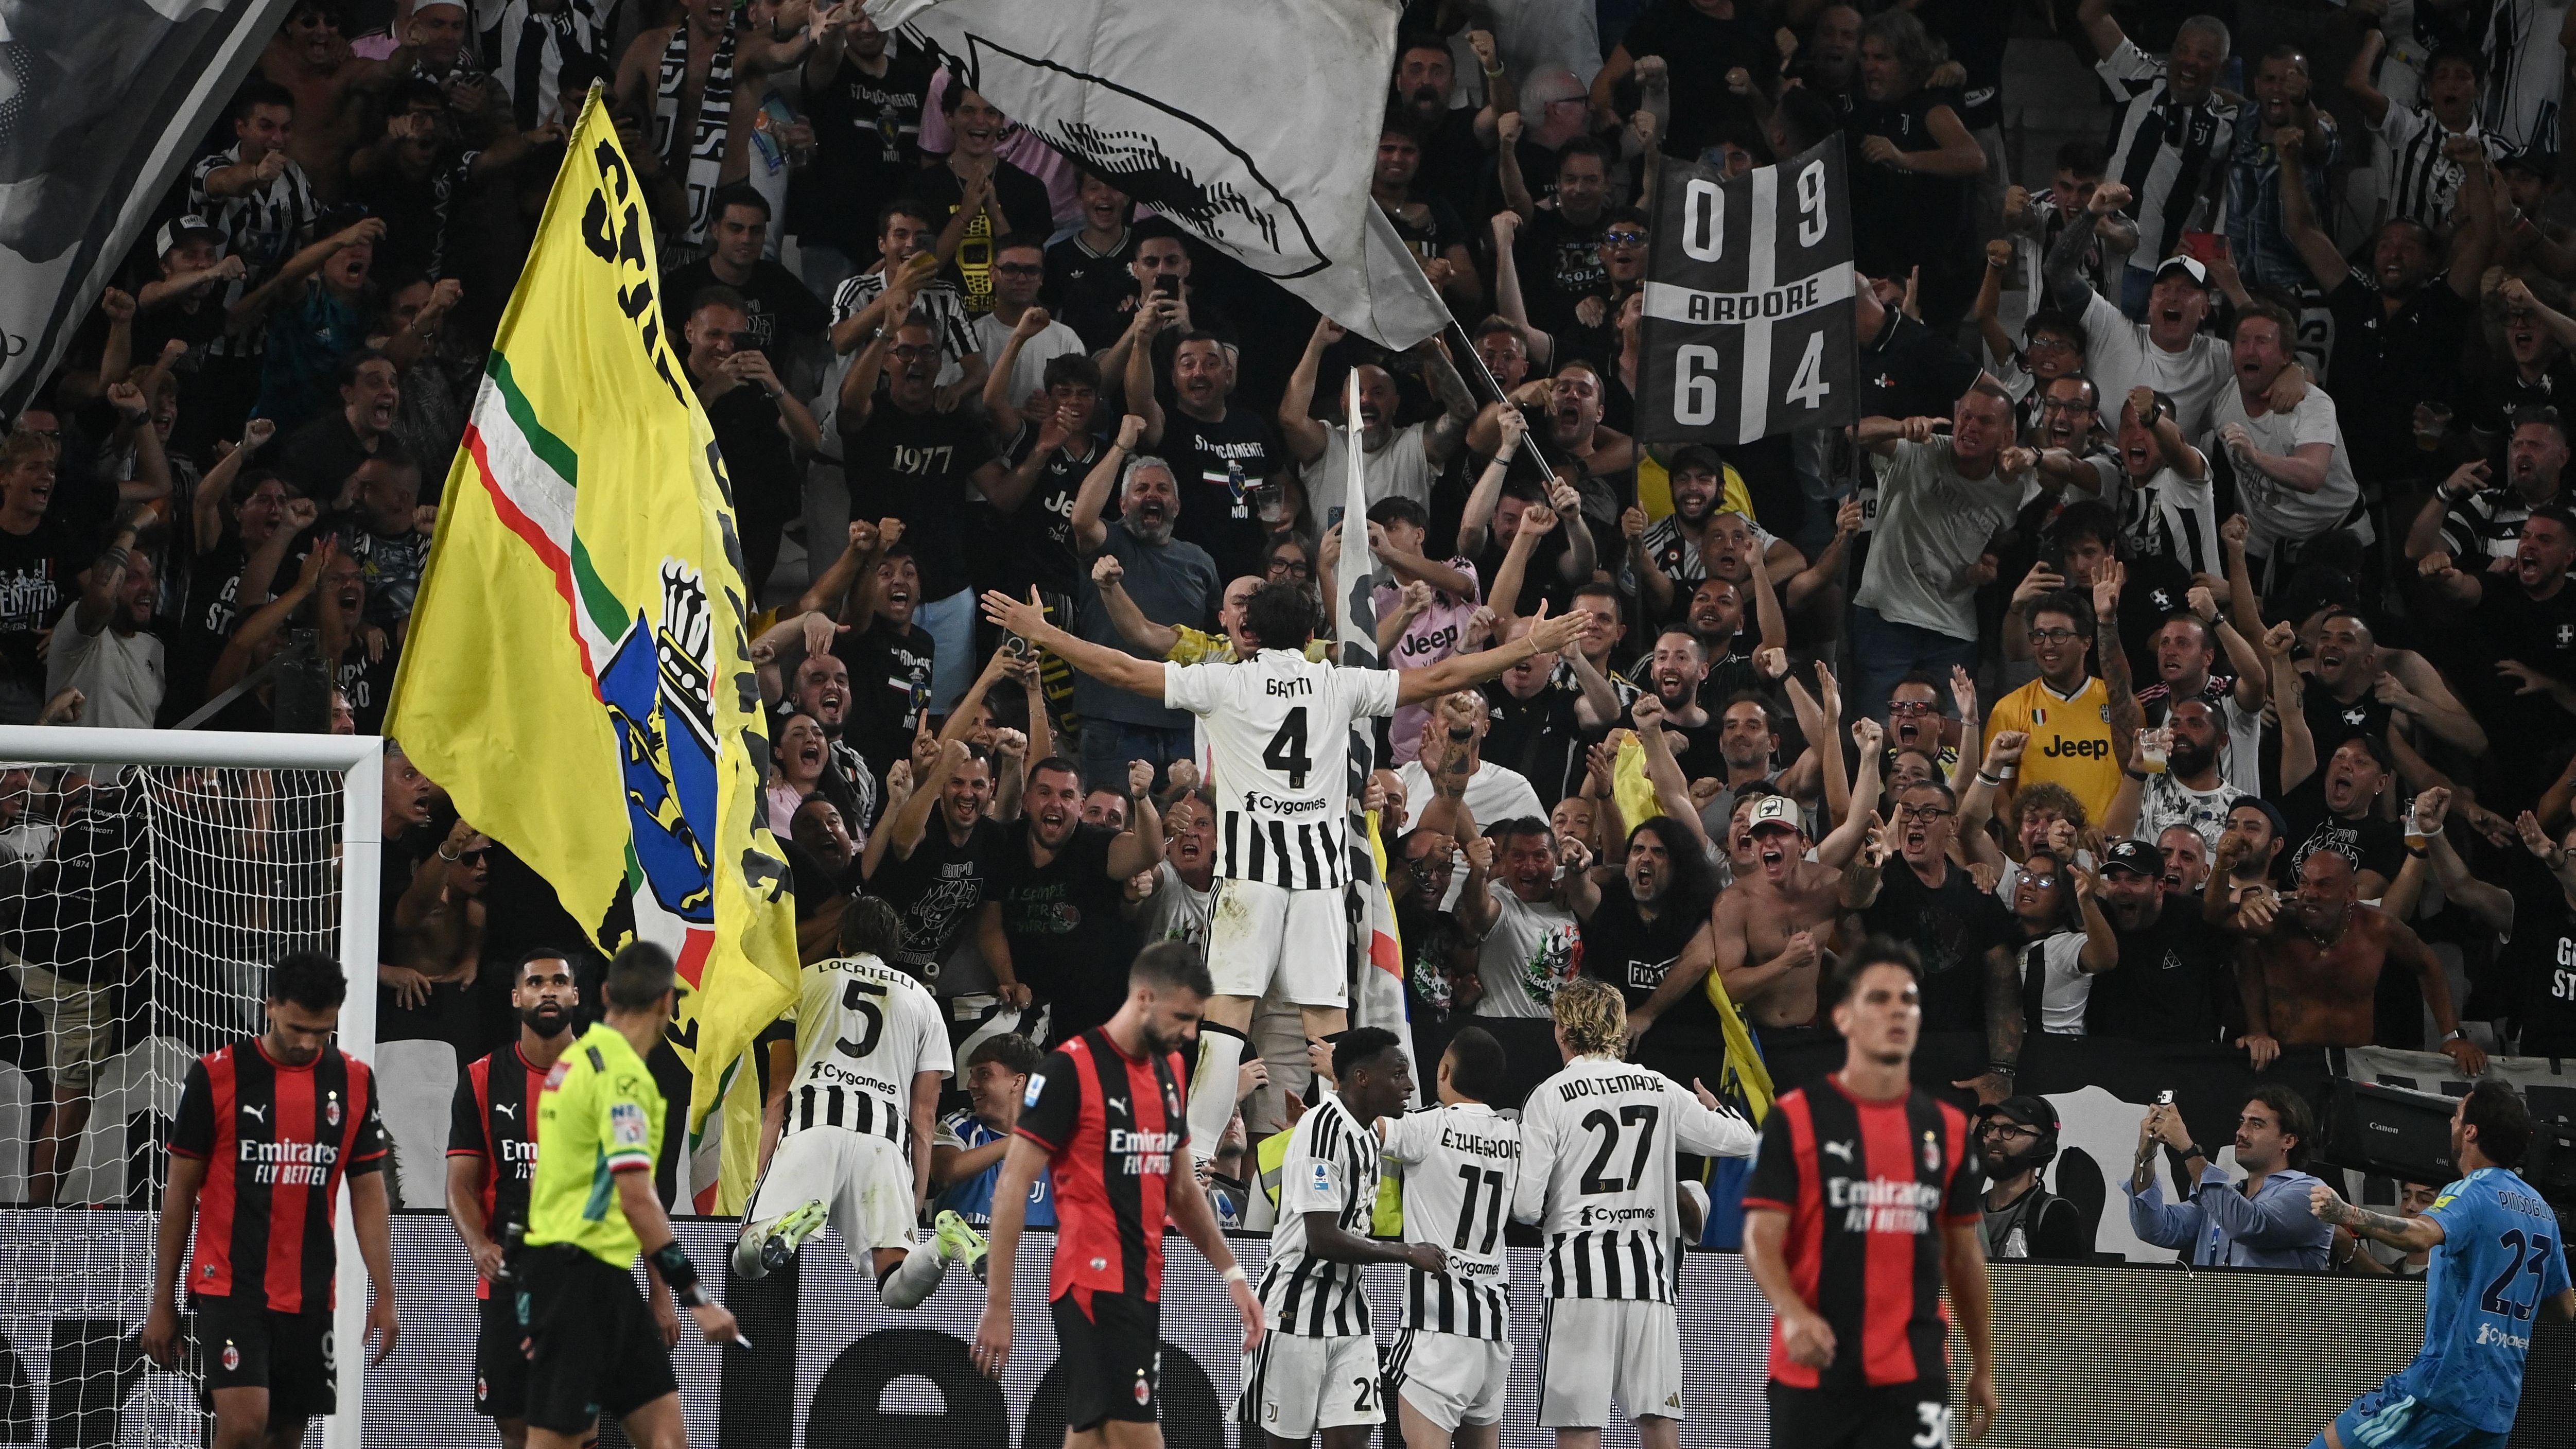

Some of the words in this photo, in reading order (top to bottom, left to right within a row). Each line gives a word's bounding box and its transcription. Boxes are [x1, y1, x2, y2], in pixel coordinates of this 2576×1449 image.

[1682, 178, 1725, 263] 0
[1797, 159, 1827, 248] 9
[1688, 278, 1819, 321] ARDORE
[1674, 344, 1718, 426] 6
[1786, 329, 1830, 410] 4
[889, 444, 953, 475] 1977
[1045, 490, 1076, 518] Je
[1231, 505, 1248, 519] NOI
[1401, 625, 1458, 657] Jeep
[1266, 677, 1312, 699] GATTI
[1263, 707, 1312, 789] 4
[2044, 735, 2109, 761] Jeep
[1260, 795, 1326, 815] Cygames
[73, 860, 90, 869] 1874
[819, 961, 914, 990] LOCATELLI
[835, 979, 887, 1058] 5
[824, 1064, 896, 1095] Cygames
[1559, 1075, 1664, 1102] WOLTEMADE
[1109, 1128, 1179, 1154] Emirat
[2369, 1122, 2399, 1134] Canon
[239, 1137, 339, 1163] Emirates
[1580, 1105, 1659, 1195] 27
[255, 1164, 280, 1184] FLY
[1453, 1164, 1504, 1254] 11
[1595, 1206, 1656, 1225] Cygames
[1449, 1255, 1500, 1277] Cygames
[2480, 1228, 2552, 1321] 23
[1353, 1377, 1381, 1411] 26
